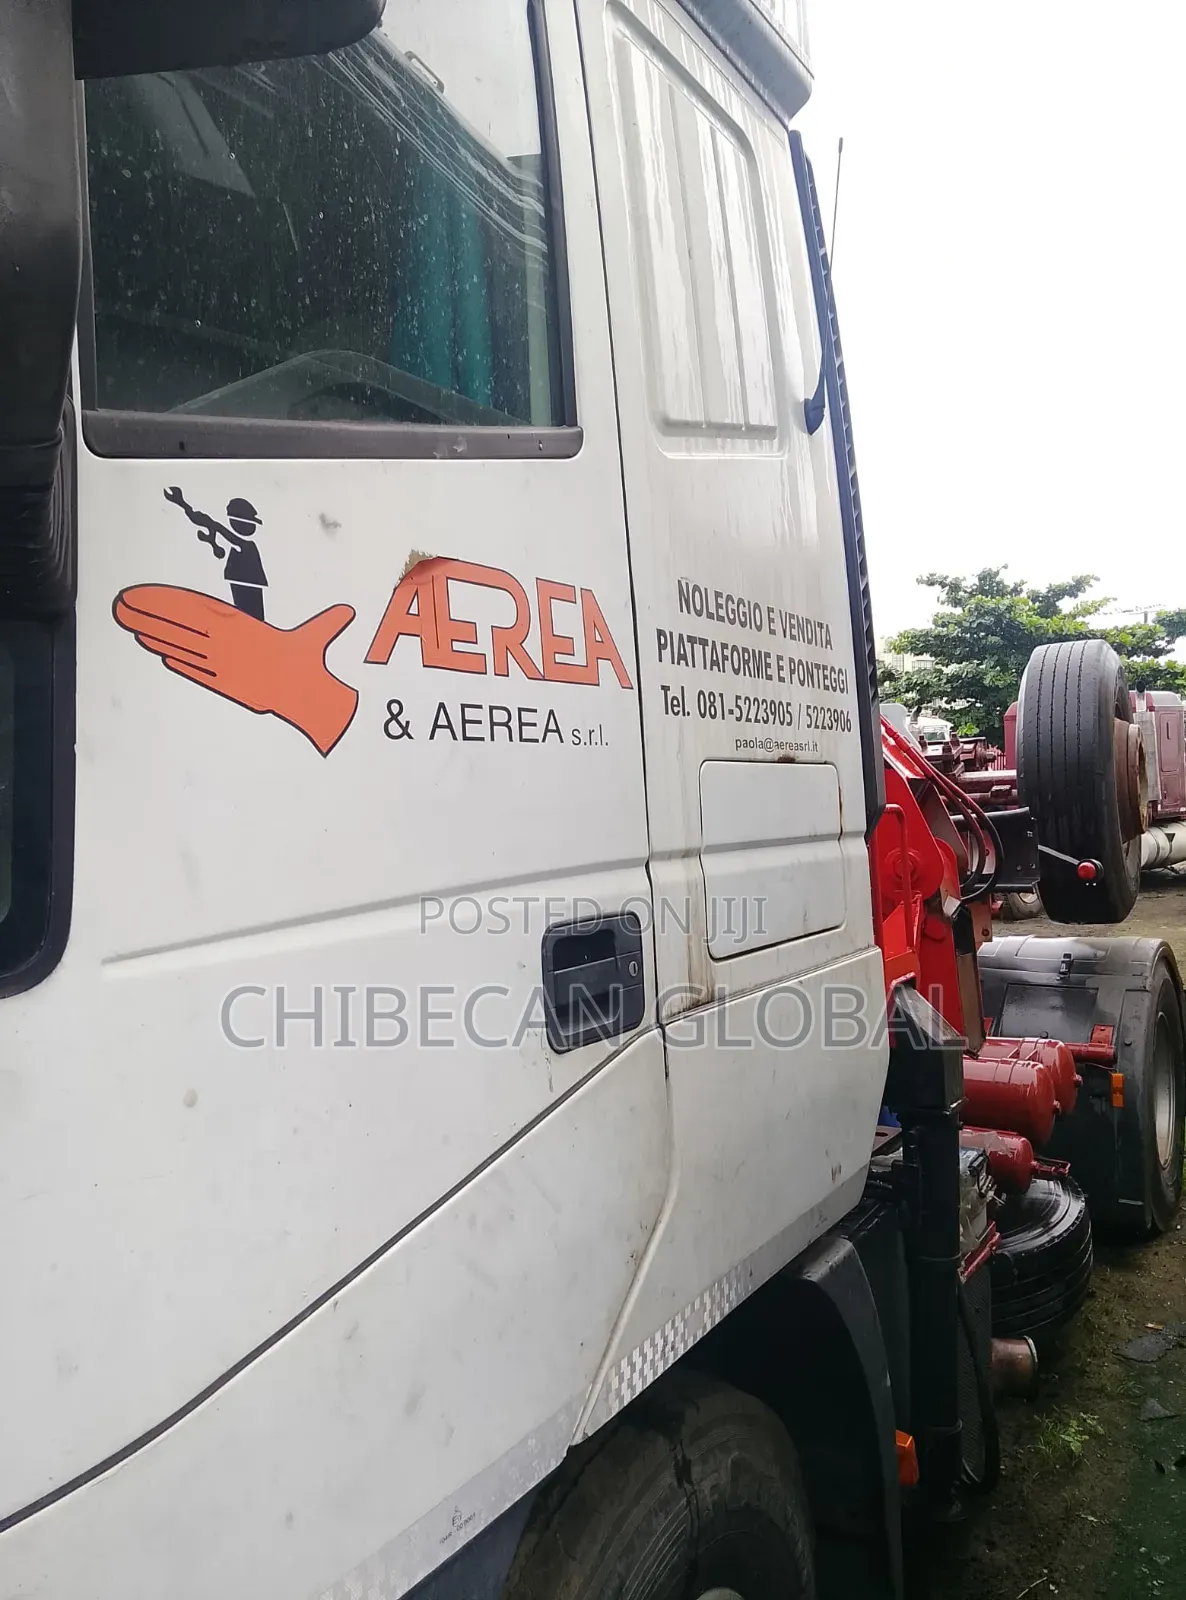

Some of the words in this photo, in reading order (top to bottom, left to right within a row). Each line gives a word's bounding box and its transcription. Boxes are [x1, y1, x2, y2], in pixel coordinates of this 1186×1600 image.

[363, 555, 634, 690] AEREA
[677, 579, 763, 633] NOLEGGIO
[766, 605, 777, 636] E
[779, 609, 834, 651] VENDITA
[656, 627, 774, 682] PIATTAFORME
[776, 654, 786, 684] E
[788, 656, 850, 695] PONTEGGI
[383, 698, 415, 741] &
[429, 701, 565, 744] AEREA
[571, 723, 609, 747] s.r.l.
[660, 684, 691, 718] Tel.
[697, 688, 794, 727] 081-5223905
[797, 702, 802, 731] /
[805, 704, 852, 733] 5223906
[735, 736, 819, 753] paola@aereasrl.it
